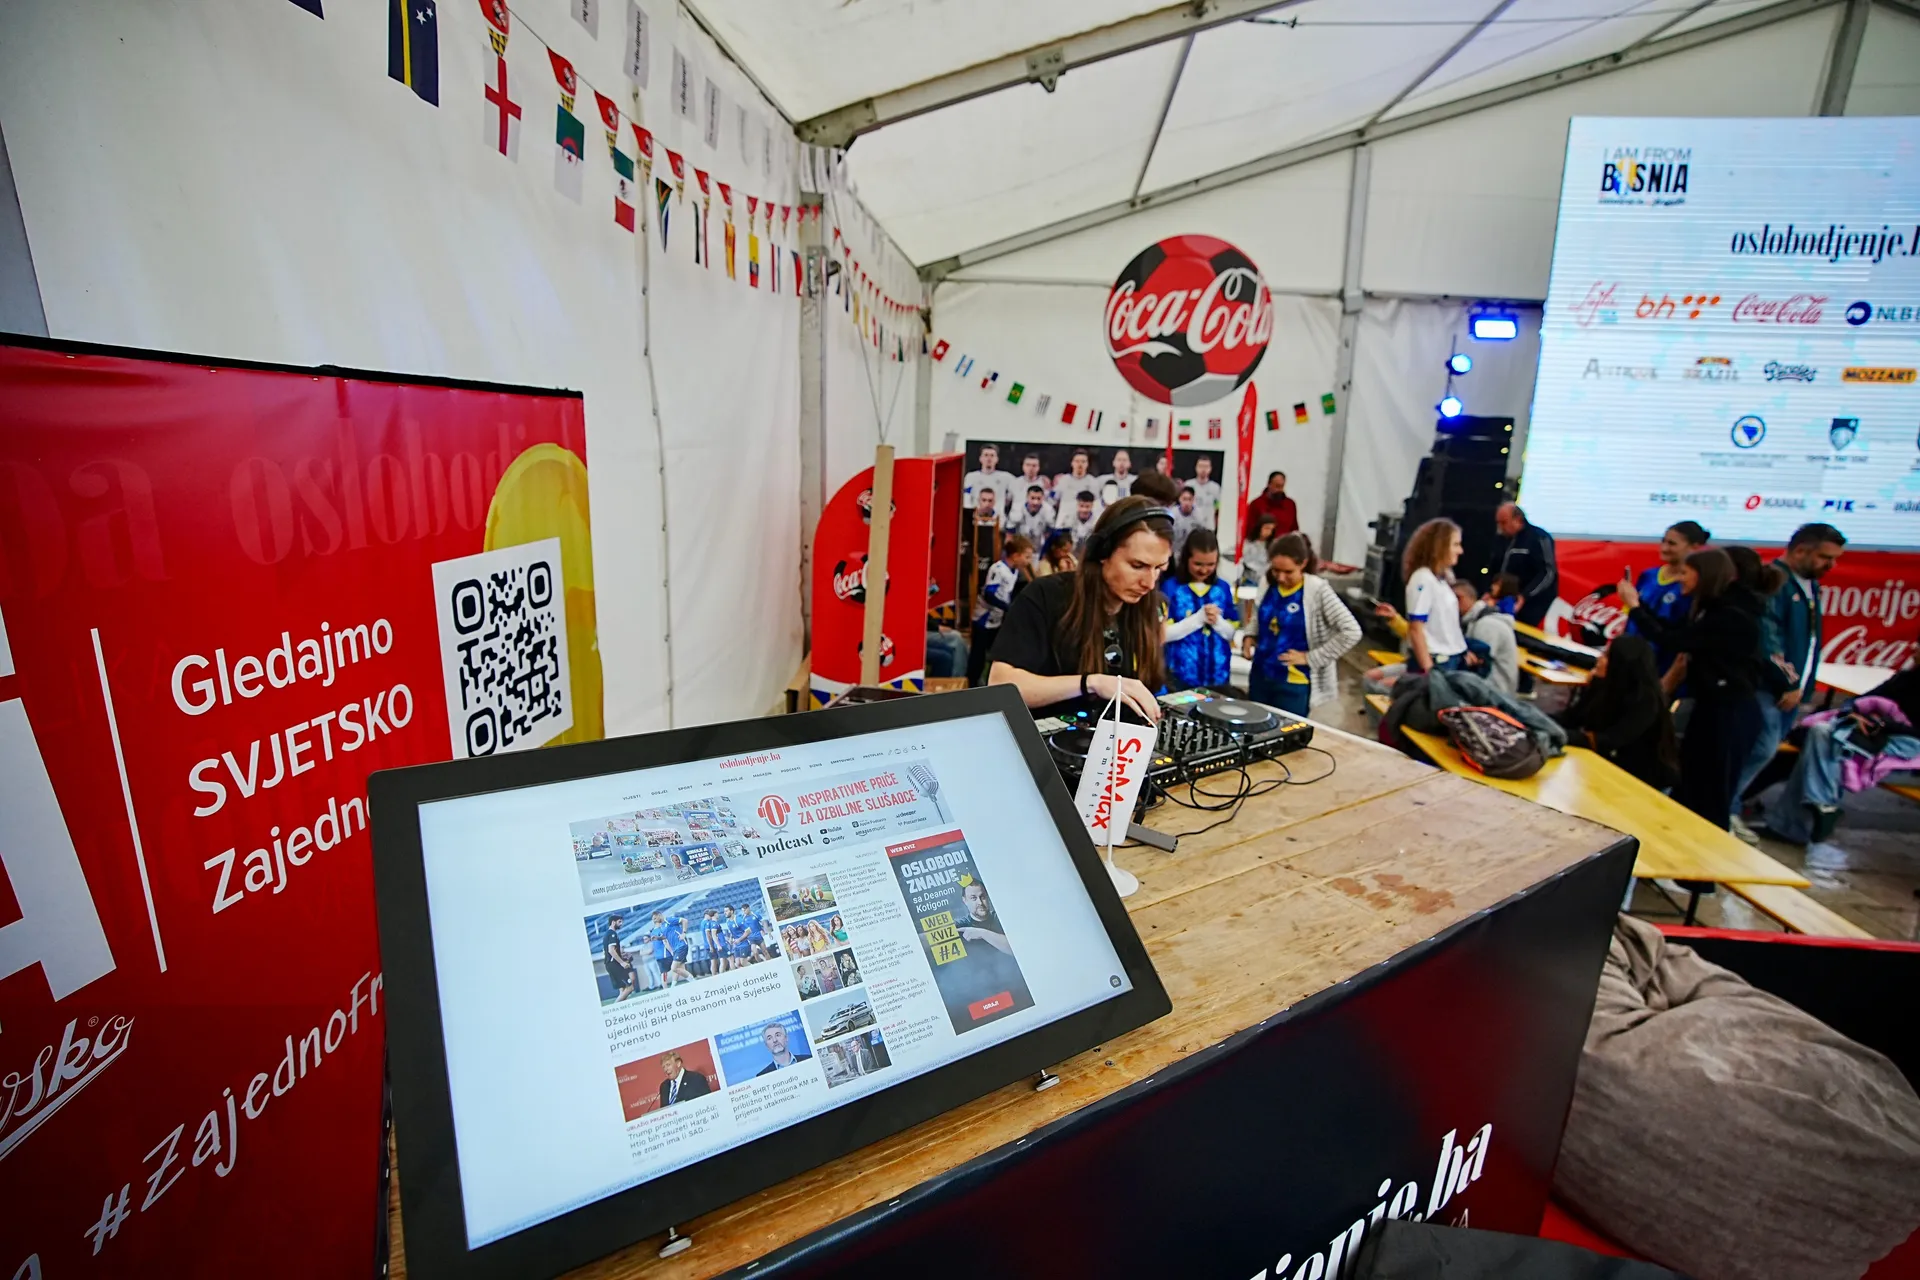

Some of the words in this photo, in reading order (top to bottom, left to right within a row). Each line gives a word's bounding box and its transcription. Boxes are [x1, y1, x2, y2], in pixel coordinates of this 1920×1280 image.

[1613, 148, 1639, 159] AM
[1644, 147, 1692, 160] FROM
[1601, 162, 1688, 194] BSNIA
[1104, 268, 1273, 359] Coca-Cola
[1819, 579, 1920, 628] mocije
[171, 618, 393, 716] Gledajmo
[187, 683, 414, 818] SVJETSKO
[719, 752, 780, 769] oslobodjenje.ba
[797, 780, 869, 807] INSPIRATIVNE
[868, 771, 898, 789] PRIČE
[1084, 734, 1115, 819] namješta
[797, 810, 814, 824] ZA
[815, 800, 863, 820] OZBILJNE
[864, 788, 916, 810] SLUŠAOCE
[203, 796, 371, 914] Zajedn
[756, 833, 813, 857] podcast
[900, 850, 967, 877] OSLOBODI
[906, 868, 959, 893] ZNANJE
[923, 886, 955, 900] Deanom
[915, 898, 949, 913] Kotigom
[924, 913, 948, 928] WEB
[930, 926, 954, 941] KVIZ
[938, 942, 960, 960] #4
[604, 1012, 636, 1027] Džeko
[639, 1002, 672, 1018] vjeruje
[675, 997, 687, 1006] da
[689, 994, 701, 1002] su
[704, 981, 739, 998] Zmajevi
[742, 971, 777, 986] donekle
[607, 1020, 647, 1040] ujedinili
[650, 1015, 667, 1025] BiH
[671, 998, 726, 1021] plasmanom
[729, 994, 740, 1002] na
[743, 981, 780, 998] Svjetsko
[609, 1030, 660, 1052] prvenstvo
[884, 1026, 907, 1037] Christian
[889, 1042, 904, 1051] odem
[732, 1097, 762, 1113] približno
[773, 1084, 797, 1097] miliona
[798, 1079, 808, 1087] KM
[752, 1084, 769, 1096] BHRT
[772, 1075, 798, 1089] ponudio
[84, 971, 384, 1257] #ZajednoFr
[628, 1127, 652, 1141] Trump
[654, 1112, 693, 1132] promijenio
[734, 1106, 761, 1121] prijenos
[630, 1139, 645, 1149] Htio
[648, 1133, 659, 1143] bih
[662, 1123, 687, 1137] zauzeti
[632, 1150, 641, 1158] ne
[644, 1142, 664, 1154] znam
[666, 1136, 679, 1145] ima
